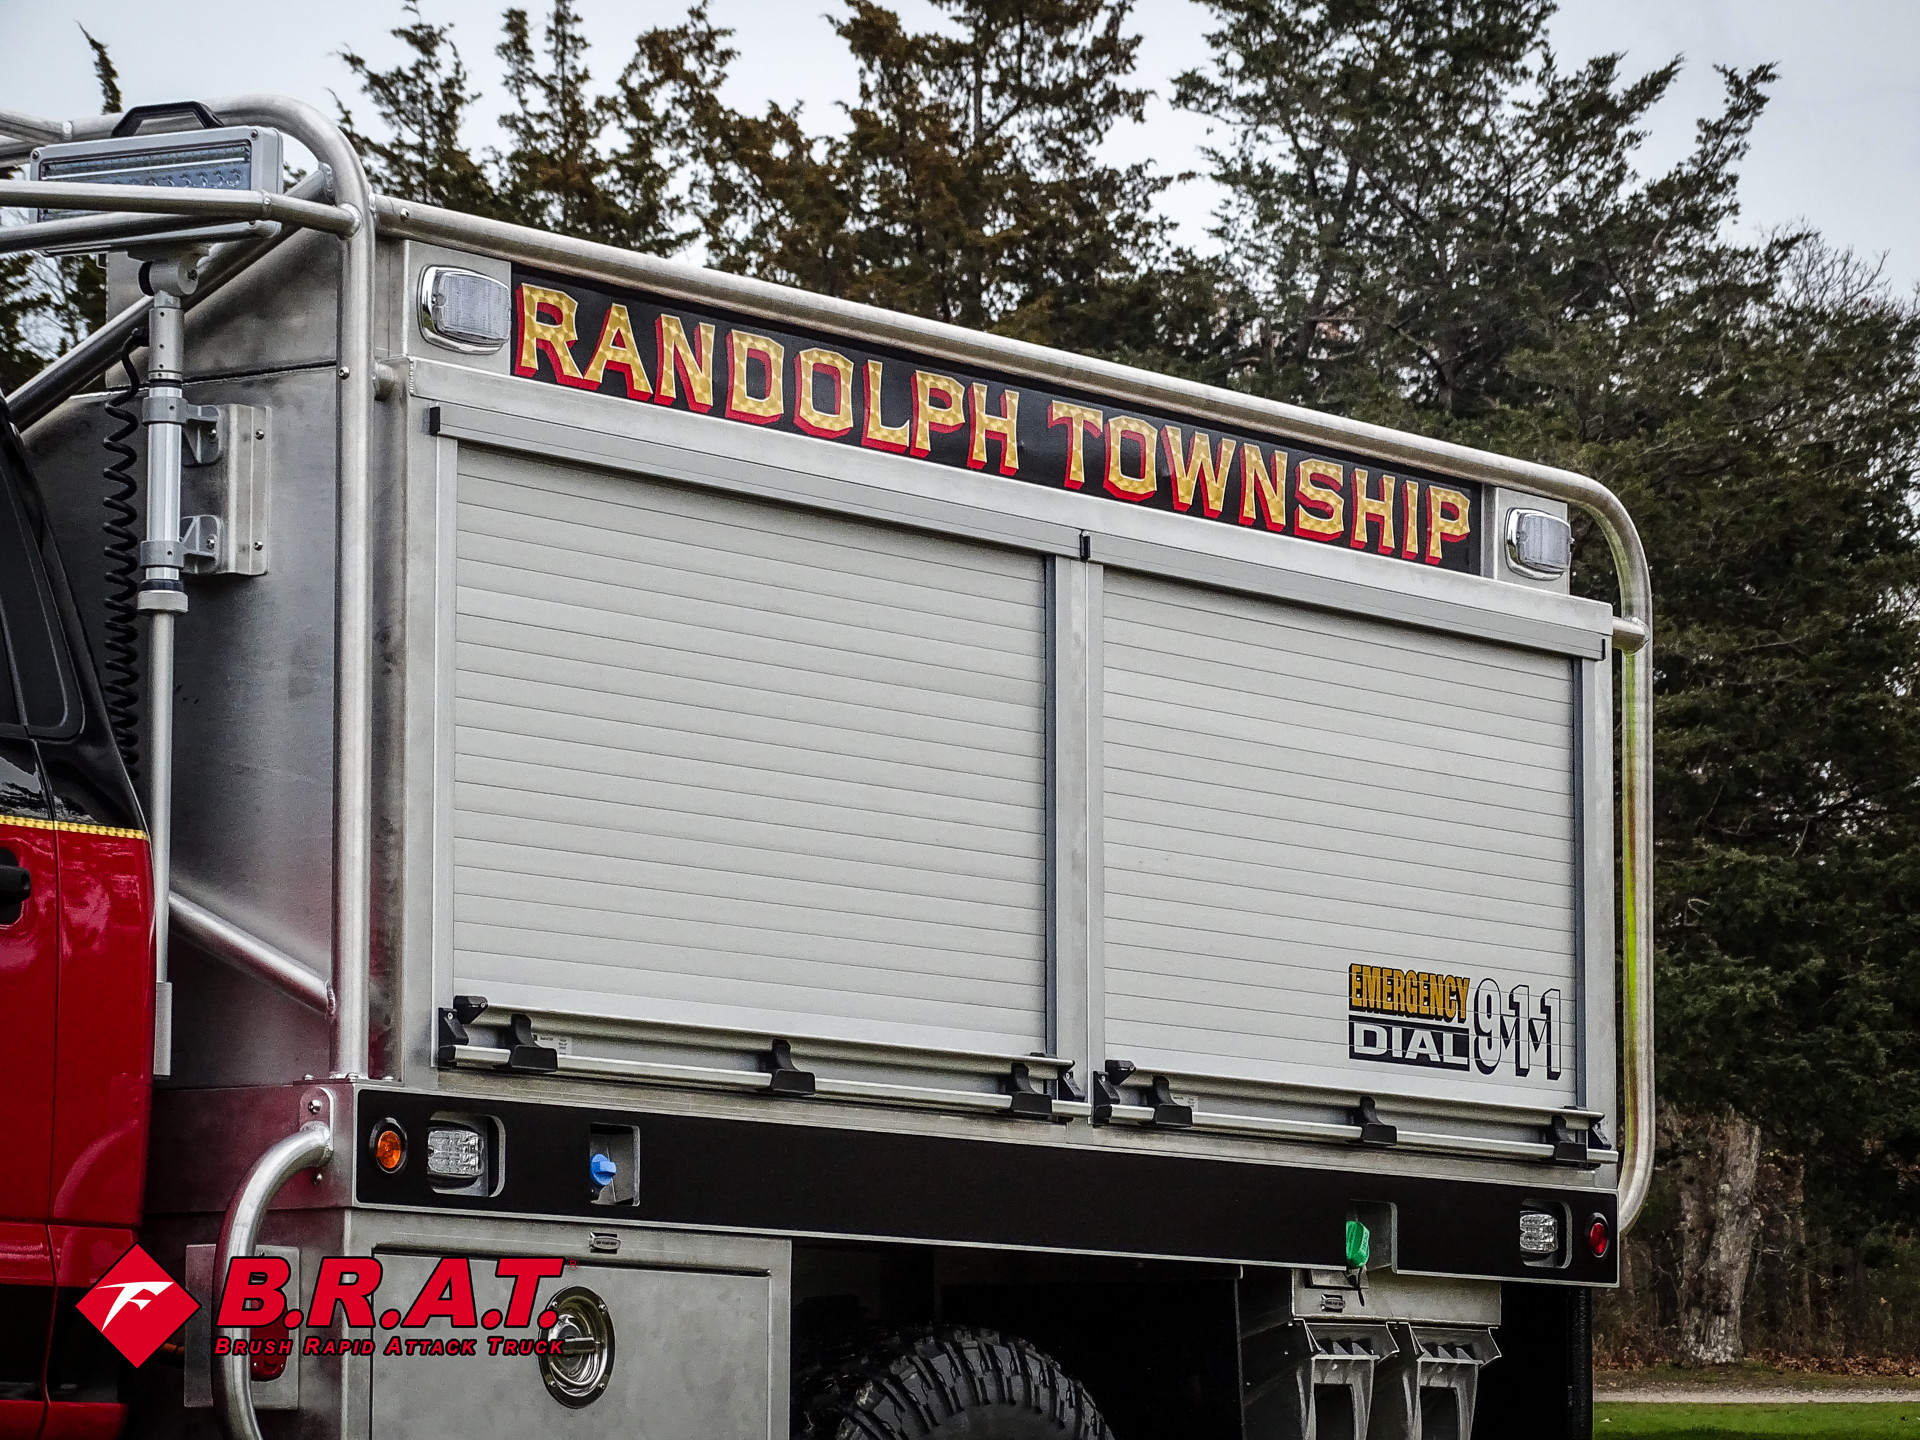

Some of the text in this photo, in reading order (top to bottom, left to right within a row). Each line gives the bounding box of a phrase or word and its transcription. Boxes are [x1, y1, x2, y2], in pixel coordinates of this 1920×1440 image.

[515, 282, 1471, 565] RANDOLPH TOWNSHIP
[1349, 963, 1470, 1024] EMERGENCY
[1353, 978, 1562, 1080] DIAL 911
